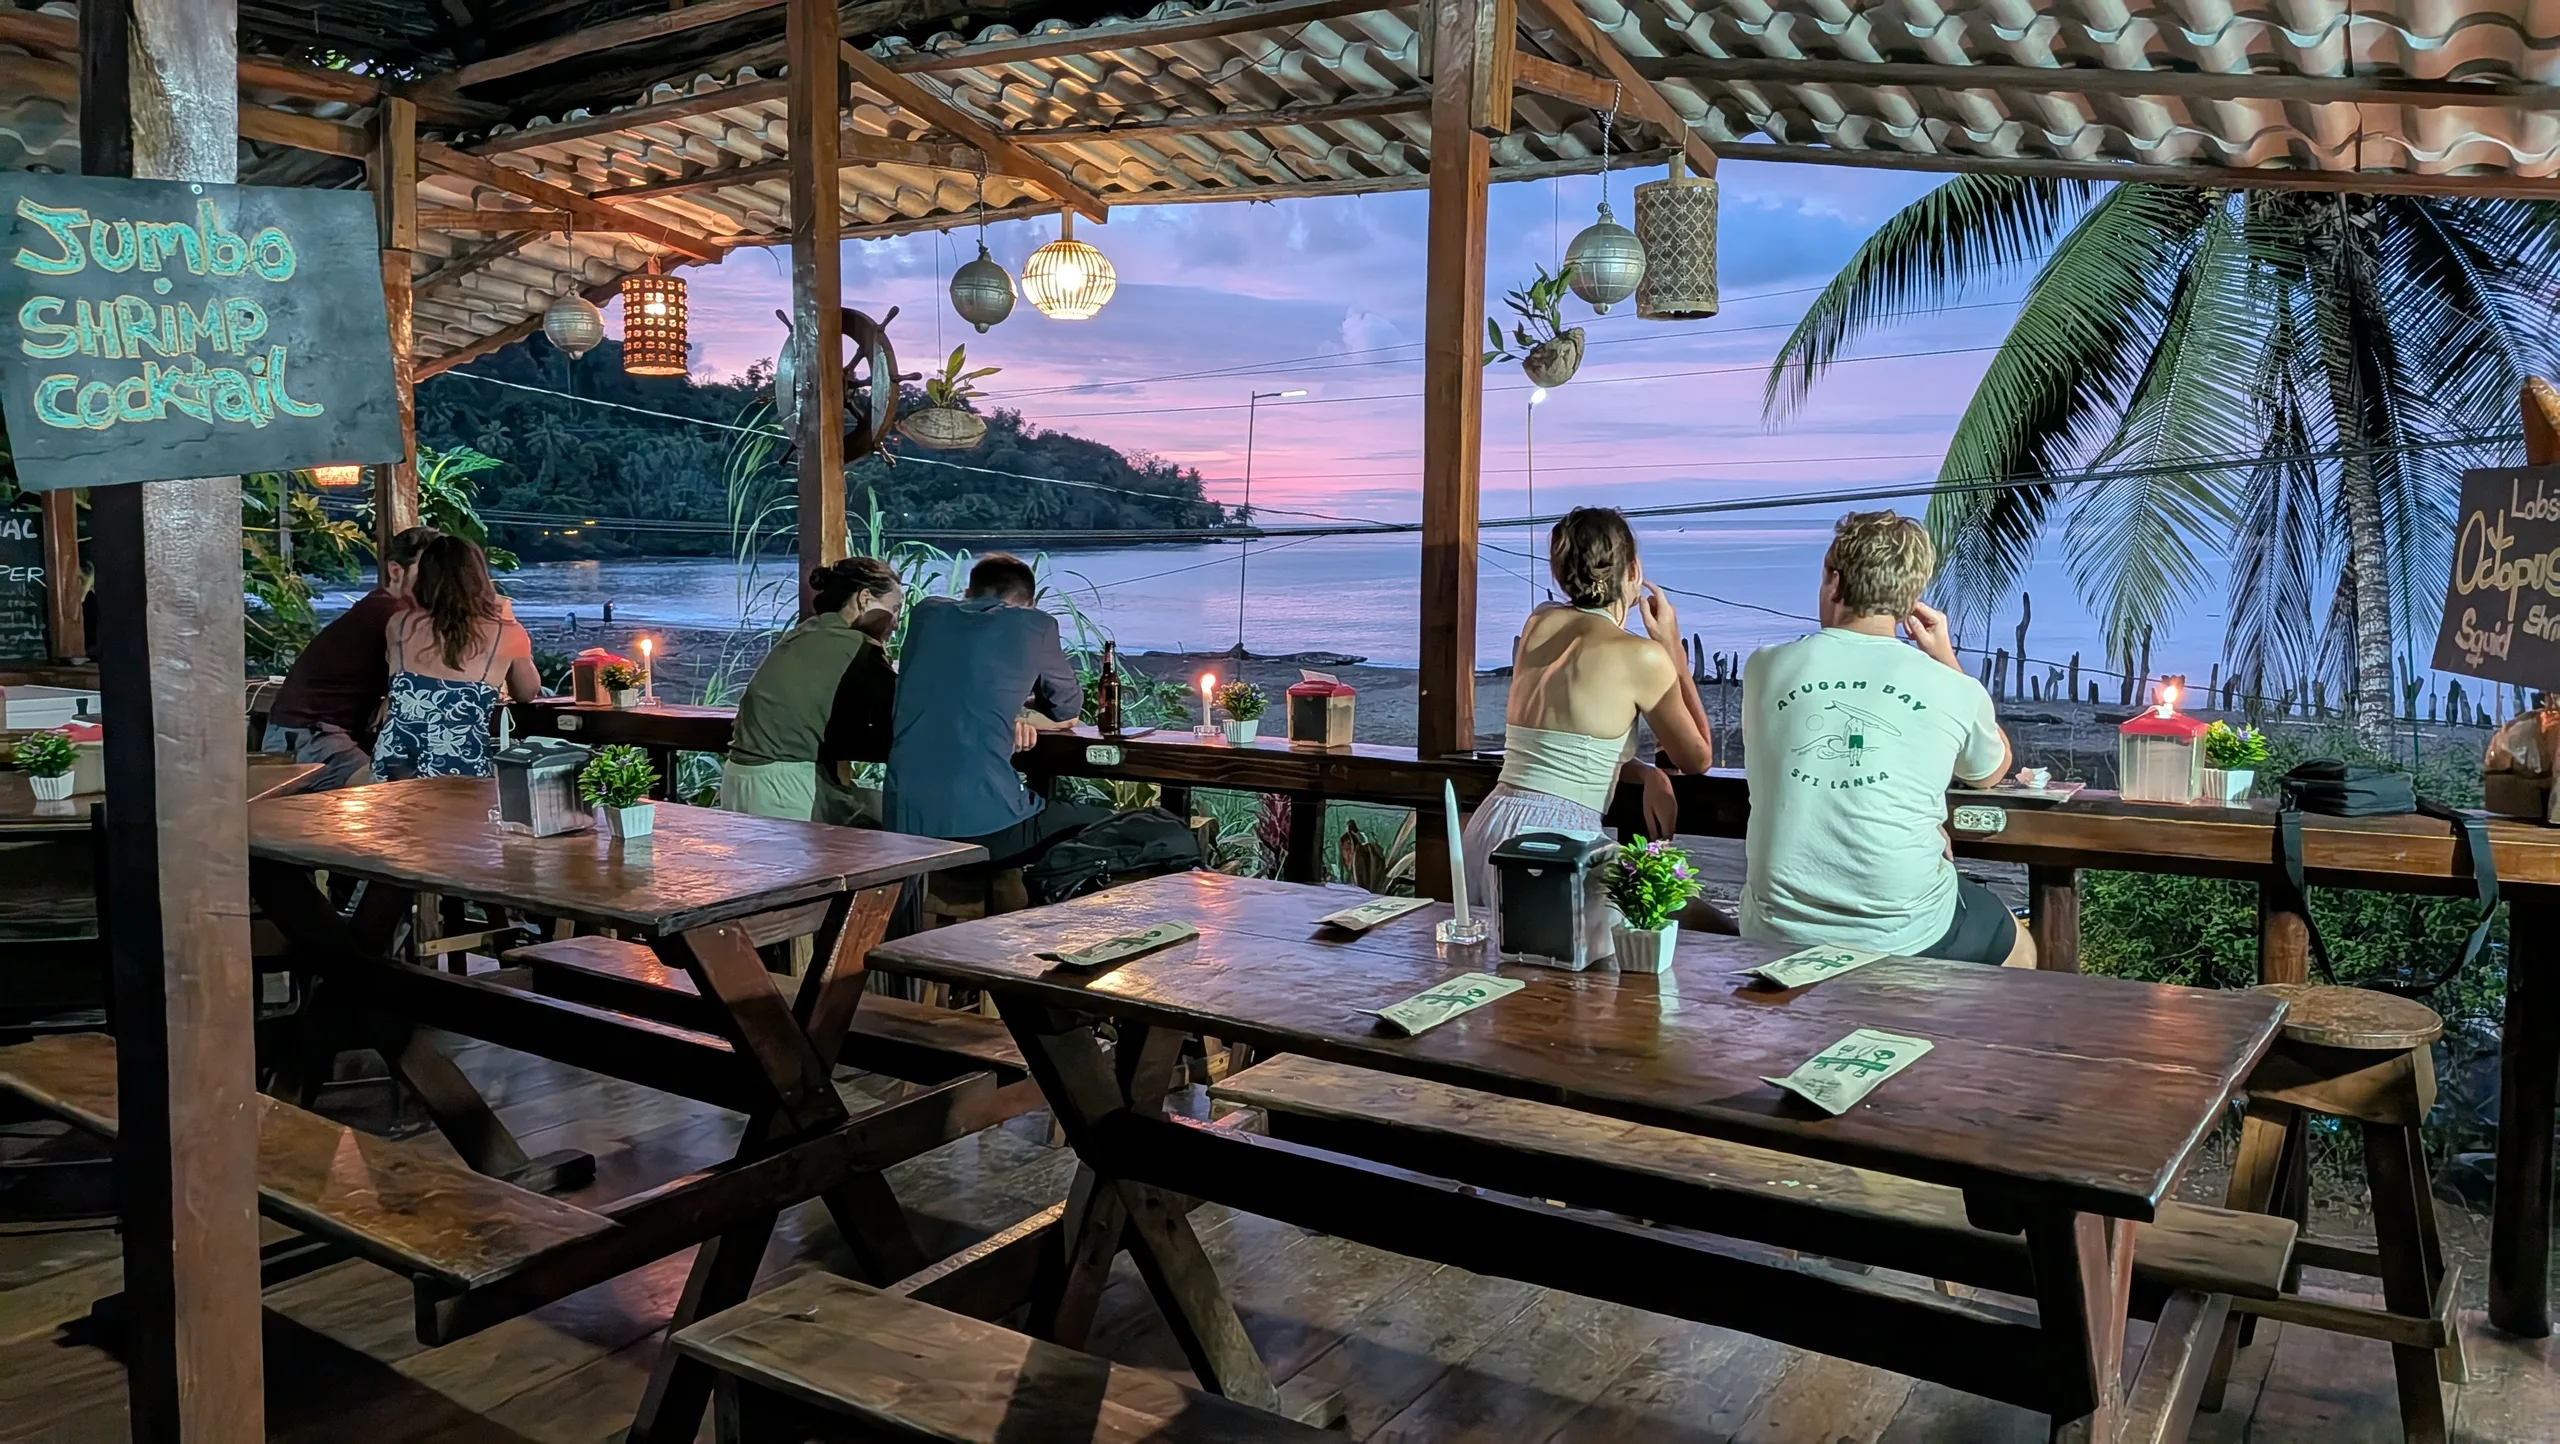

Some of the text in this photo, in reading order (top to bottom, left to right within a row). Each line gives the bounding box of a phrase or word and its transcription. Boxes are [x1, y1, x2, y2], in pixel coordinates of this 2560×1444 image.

[14, 196, 297, 282] Jumbo
[1882, 684, 1927, 711] BAY
[1830, 771, 1889, 789] LANKA
